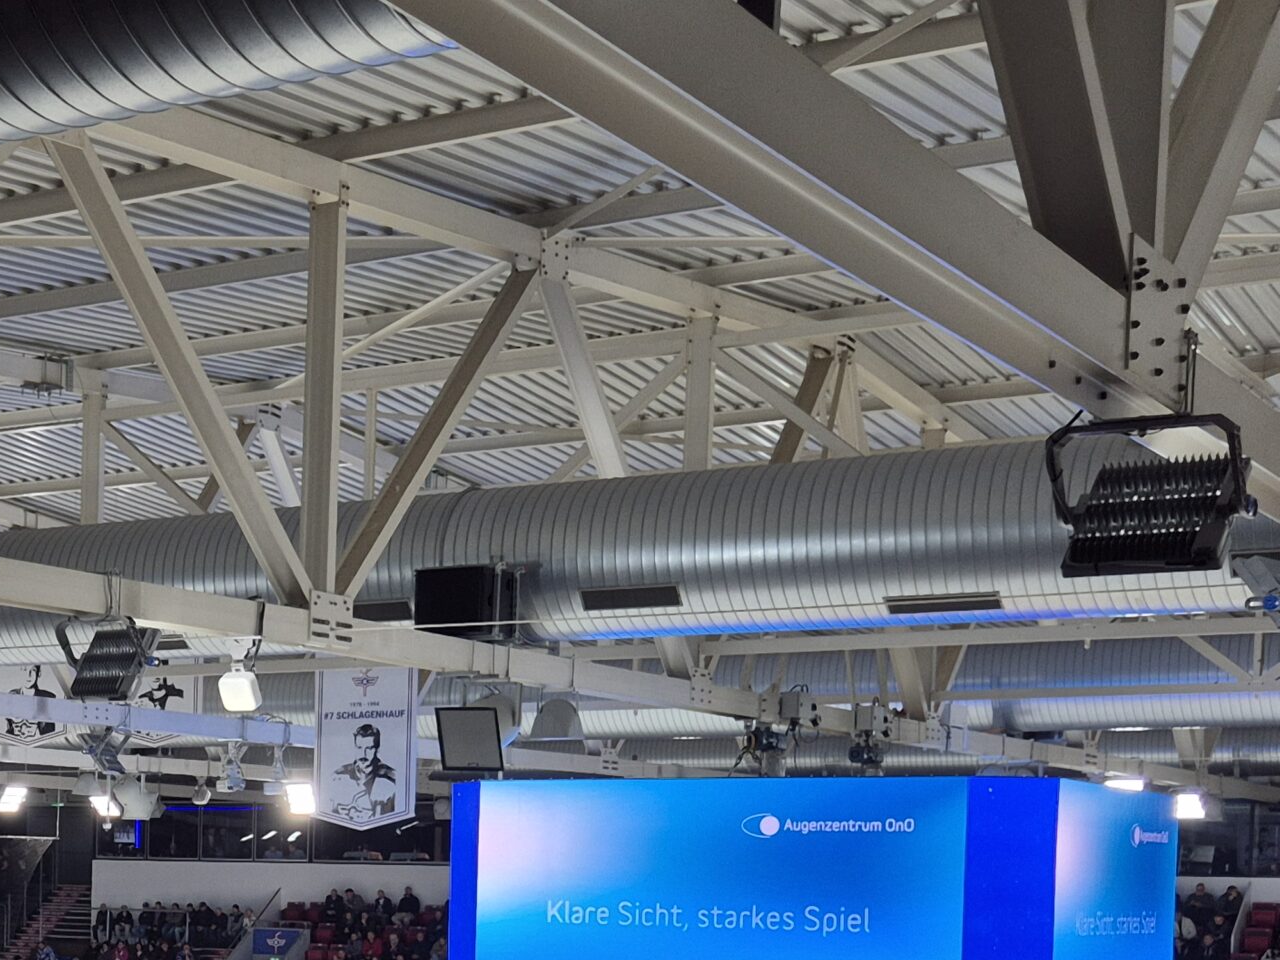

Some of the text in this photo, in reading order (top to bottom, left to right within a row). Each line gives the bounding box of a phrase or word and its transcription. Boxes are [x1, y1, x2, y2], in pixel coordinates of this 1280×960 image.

[324, 709, 406, 720] #7 SCHLAGENHAUF
[784, 818, 915, 834] Augenzentrum OnO
[546, 899, 870, 937] Klare Sicht, starkes Spiel
